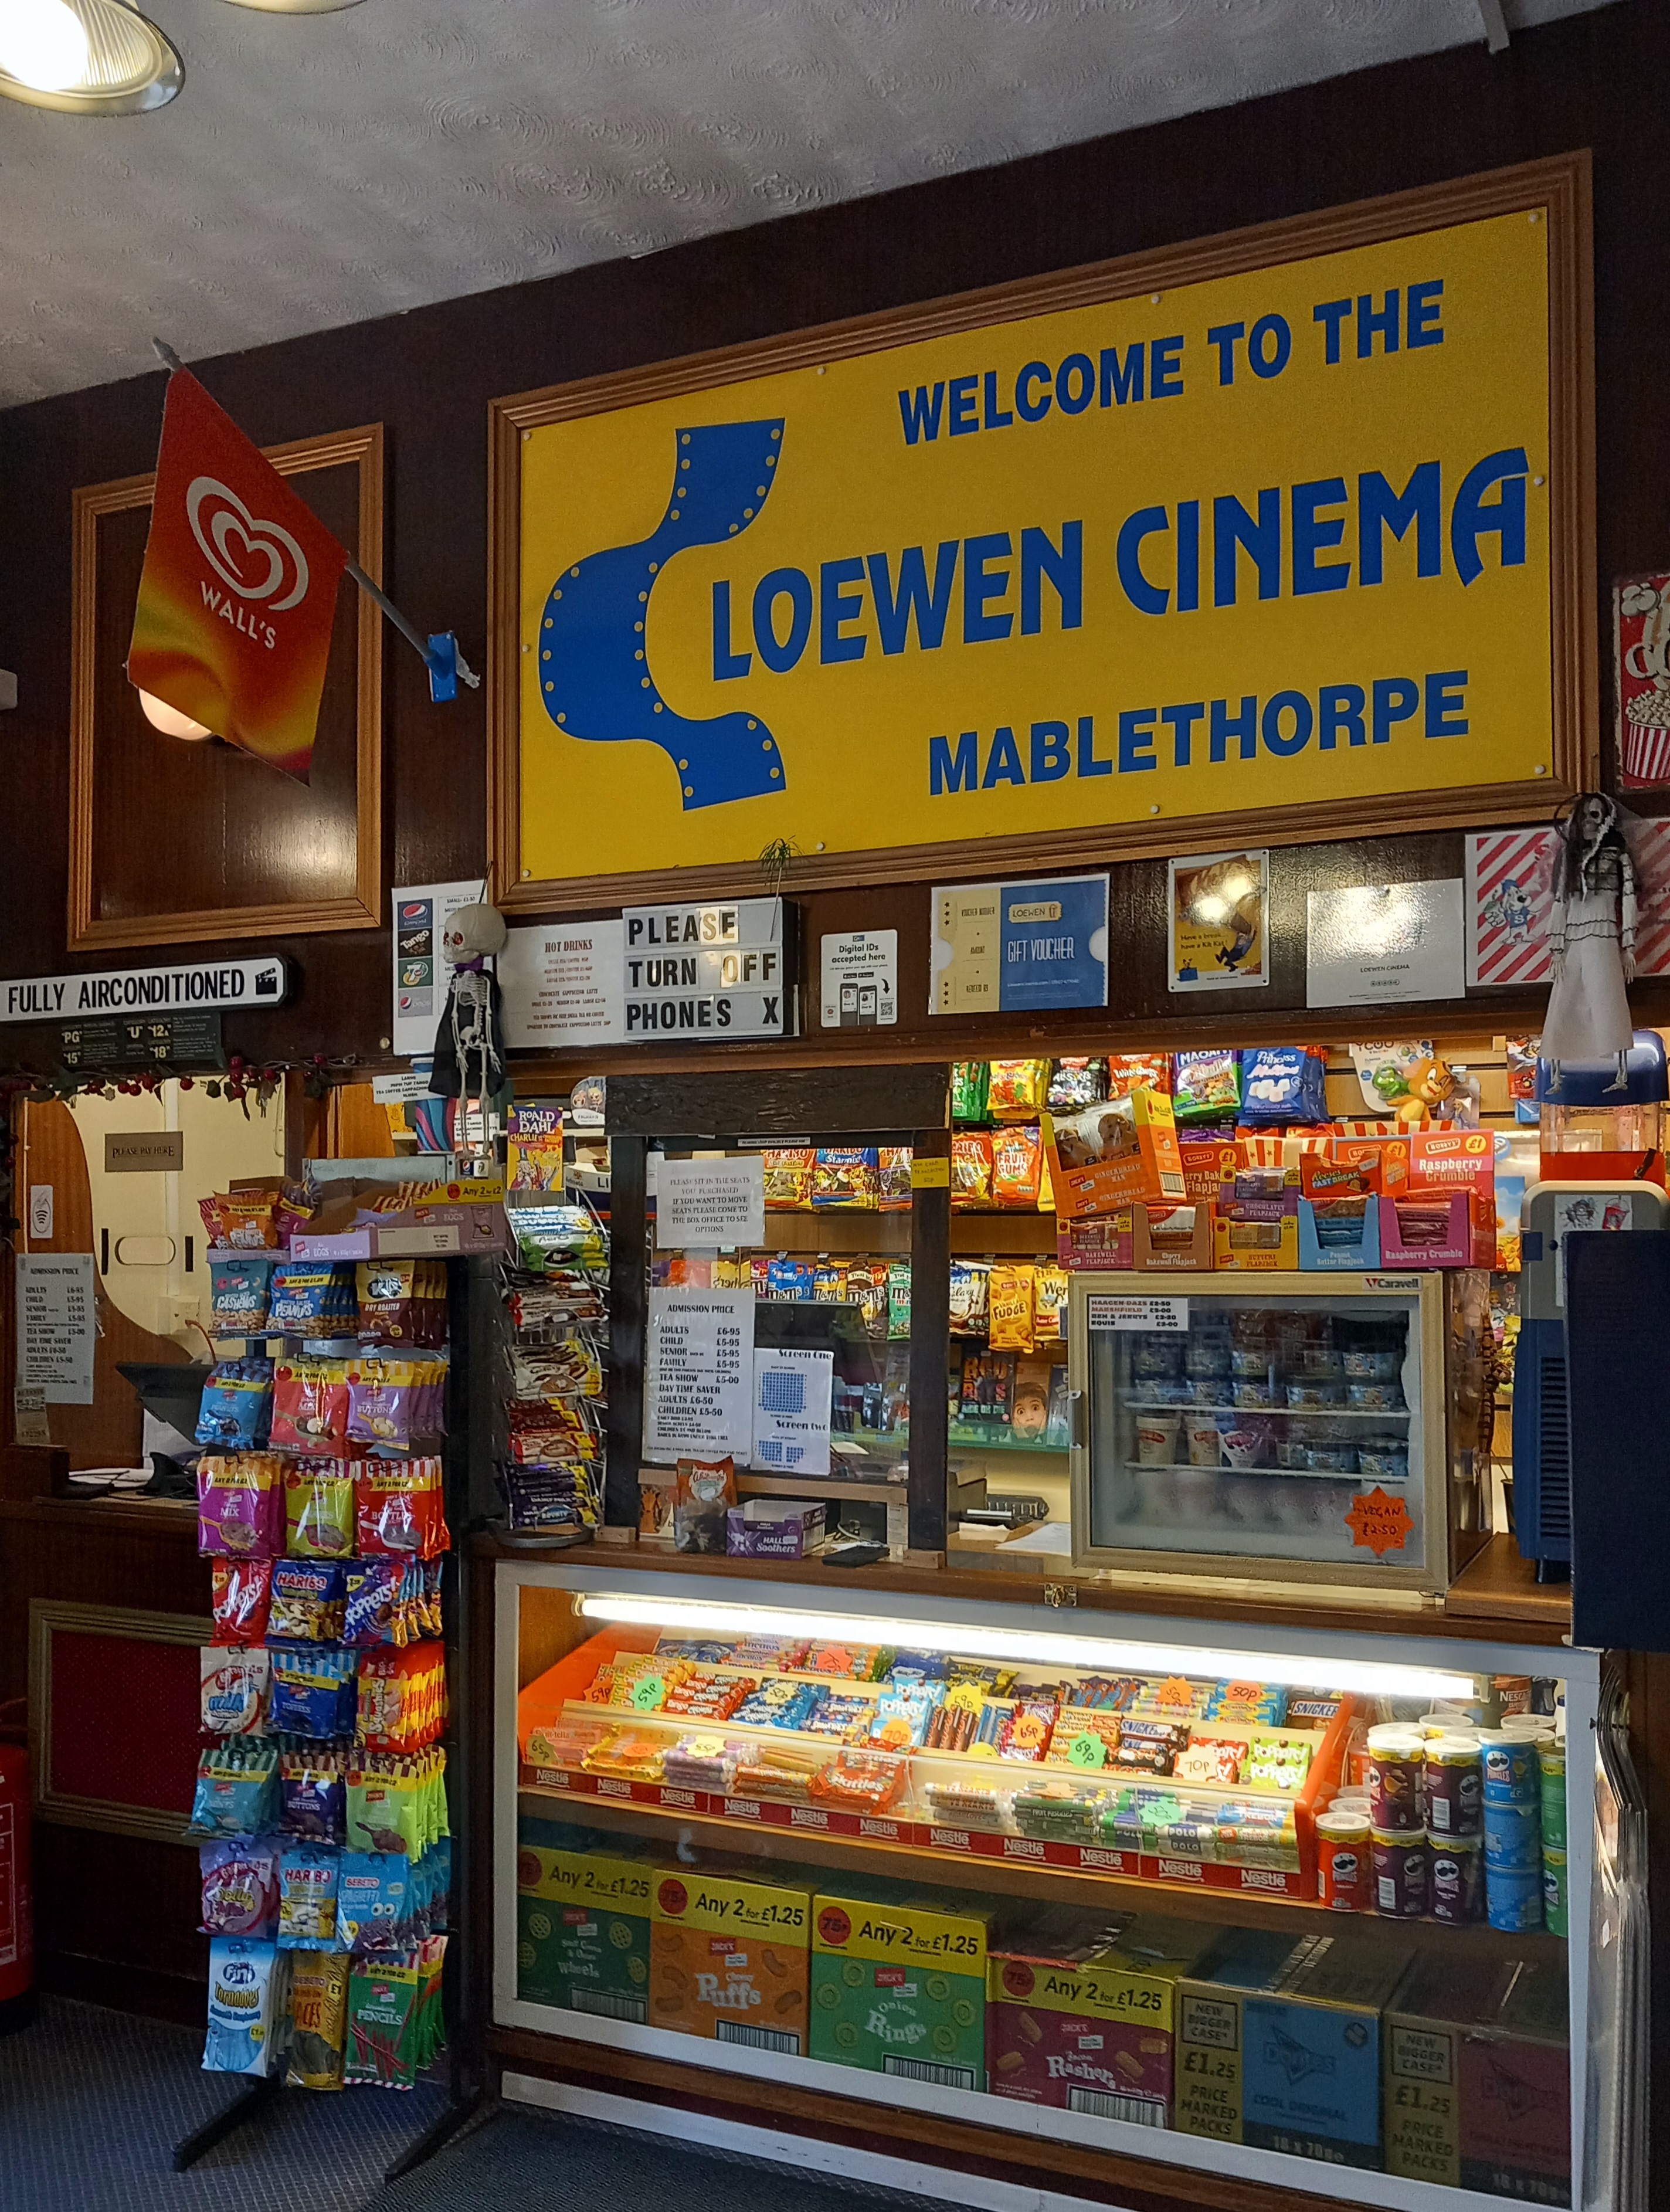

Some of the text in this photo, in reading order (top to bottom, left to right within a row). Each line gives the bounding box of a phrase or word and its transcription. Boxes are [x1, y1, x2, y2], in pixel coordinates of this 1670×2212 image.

[898, 279, 1445, 446] WELCOME TO THE
[711, 446, 1530, 681] LOEWEN CINEMA
[201, 581, 276, 649] WALL'S
[928, 669, 1469, 796] MABLETHORPE
[1013, 908, 1045, 917] LOEWEN
[629, 911, 735, 945] PLEASE
[400, 929, 430, 950] Tango
[545, 939, 592, 953] HOT DRINKS
[839, 944, 864, 954] Digital
[1008, 937, 1074, 962] GIFT VOUCHER
[832, 954, 866, 963] accepted
[629, 952, 777, 988] TURN OFF
[8, 968, 245, 1014] FULLY AIRCONDITIONED
[627, 999, 731, 1030] PHONES
[763, 996, 779, 1024] X
[519, 1110, 555, 1122] ROALD
[519, 1121, 555, 1135] DAHL
[510, 1132, 538, 1142] CHARLIE
[1468, 1139, 1482, 1149] £1
[113, 1148, 137, 1159] PLEASE
[154, 1146, 175, 1156] HERE
[998, 1152, 1028, 1163] FRUIT
[1221, 1152, 1233, 1162] £1
[1419, 1159, 1482, 1172] Raspberry
[1312, 1171, 1360, 1189] FAST BREAK
[1425, 1171, 1475, 1182] Crumble
[463, 1187, 478, 1197] Any
[480, 1186, 485, 1195] 2
[1385, 1249, 1463, 1260] Raspberry Crumble
[1377, 1279, 1420, 1288] Caravell
[217, 1294, 256, 1311] CASHEWS
[378, 1302, 400, 1311] ROASTED
[667, 1304, 735, 1314] ADMISSION PRICE
[276, 1302, 314, 1319] PEANUTS
[993, 1304, 1027, 1321] FUDGE
[660, 1326, 741, 1336] ADULTS £6-95
[660, 1336, 739, 1346] CHILD £5-95
[660, 1348, 740, 1358] SENIOR £5-95
[779, 1348, 831, 1360] Screen One
[660, 1358, 740, 1368] FAMILY £5-95
[660, 1373, 739, 1384] TEA SHOW £5-00
[659, 1383, 721, 1394] DAY TIME SAVER
[658, 1395, 714, 1405] ADULTS £6-50
[357, 1405, 392, 1413] BUTTONS
[658, 1406, 722, 1416] CHILDREN £5-50
[776, 1420, 828, 1431] Screen two
[220, 1508, 240, 1517] MIX
[1363, 1505, 1400, 1519] VEGAN
[756, 1542, 796, 1556] Soothers
[277, 1571, 327, 1590] HARIBO
[592, 1687, 611, 1702] 59p
[637, 1681, 656, 1704] 59p
[1232, 1685, 1258, 1701] 50p
[531, 1741, 551, 1760] 65p
[885, 1723, 1095, 1764] 70p 65p 69p
[1187, 1760, 1210, 1774] 70p
[831, 1775, 885, 1793] Skittles
[287, 1801, 321, 1811] BUTTONS
[1169, 1827, 1196, 1837] POLO
[1173, 1842, 1199, 1851] POLO
[285, 1870, 332, 1884] HARIBO
[346, 1878, 381, 1888] BEBETO
[548, 1866, 649, 1898] Any 2 £1.25
[695, 1893, 804, 1926] Any 2 £1.25
[859, 1921, 979, 1956] Any 2 £1.25
[224, 1965, 254, 1981] Fini
[696, 1972, 761, 2010] Puffs
[1044, 1977, 1162, 2011] Any 2 £1.25
[878, 2002, 917, 2017] Onion
[1196, 2003, 1224, 2017] NEW
[357, 2009, 403, 2025] PENCILS
[1188, 2013, 1231, 2031] BIGGER
[865, 2009, 926, 2045] Rings
[1046, 2055, 1116, 2090] Rashers
[1184, 2052, 1237, 2079] £1.25
[1190, 2085, 1227, 2103] PRICE
[1180, 2099, 1237, 2121] MARKED
[1189, 2116, 1232, 2136] PACKS
